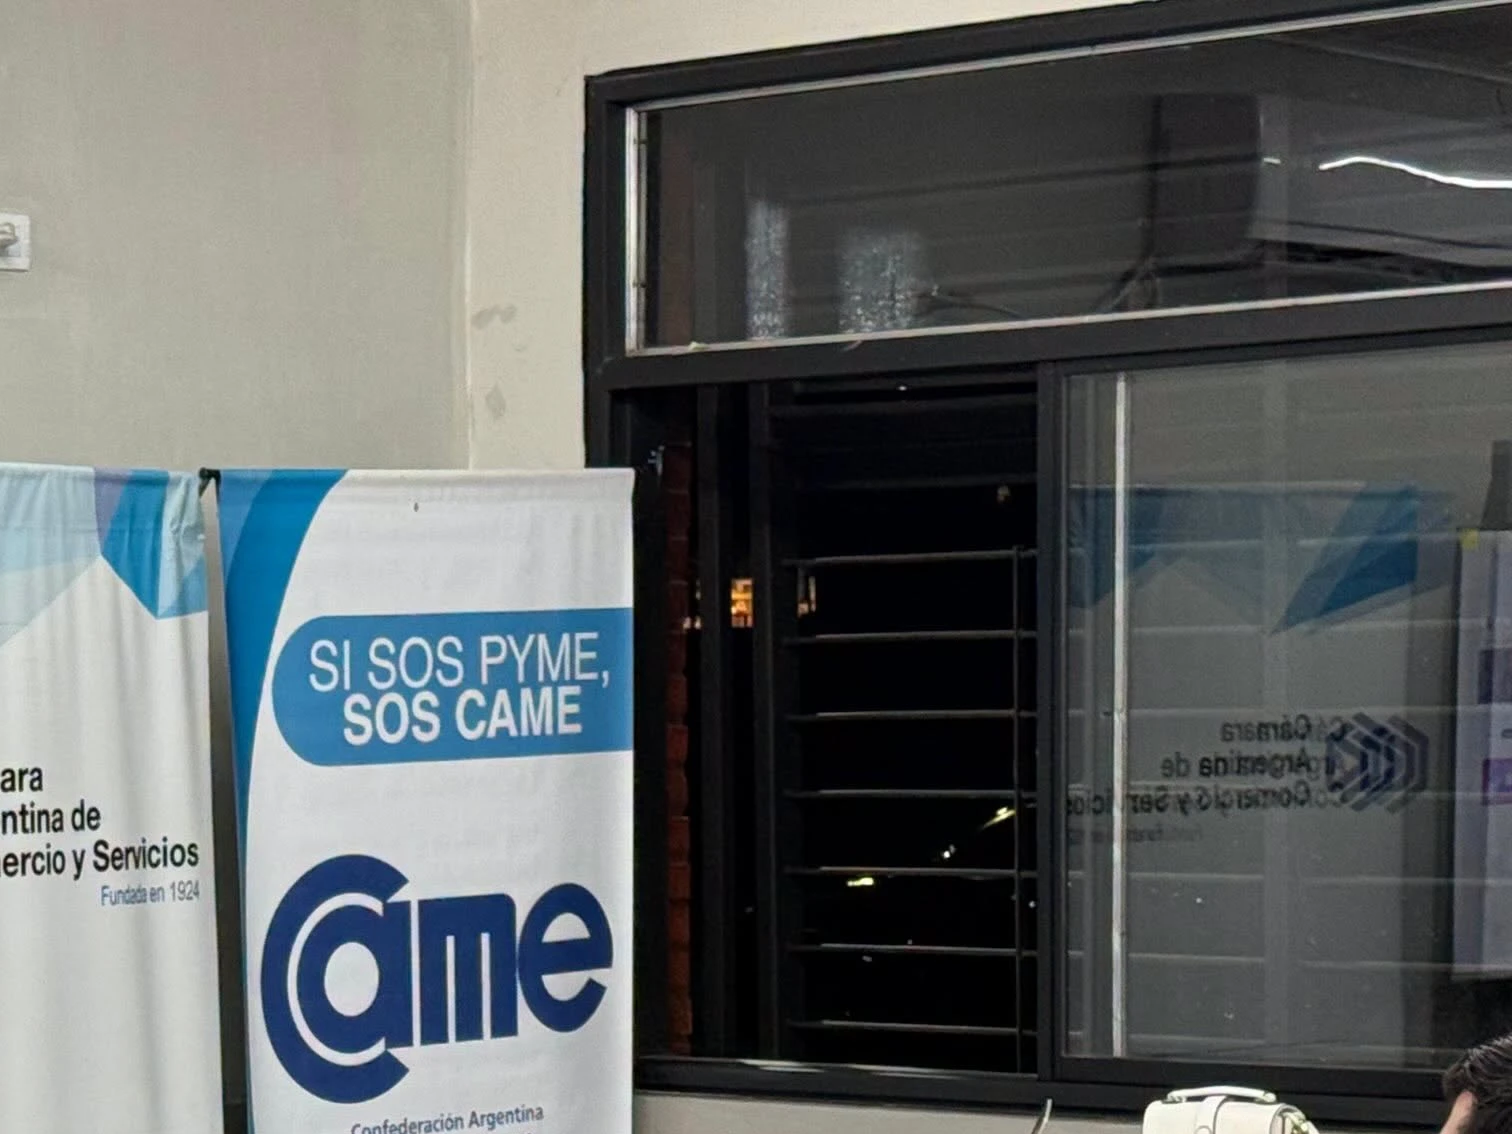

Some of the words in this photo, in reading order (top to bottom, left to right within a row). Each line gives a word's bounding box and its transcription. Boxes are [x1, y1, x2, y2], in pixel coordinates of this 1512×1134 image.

[309, 638, 351, 692] SI
[368, 635, 464, 689] SOS
[480, 632, 609, 688] PYME,
[343, 690, 440, 746] SOS
[455, 685, 582, 741] CAME
[71, 799, 101, 831] de
[73, 849, 86, 880] y
[92, 836, 199, 872] Servicios
[149, 888, 165, 902] en
[170, 880, 200, 901] 1924
[468, 1104, 544, 1131] Argentina
